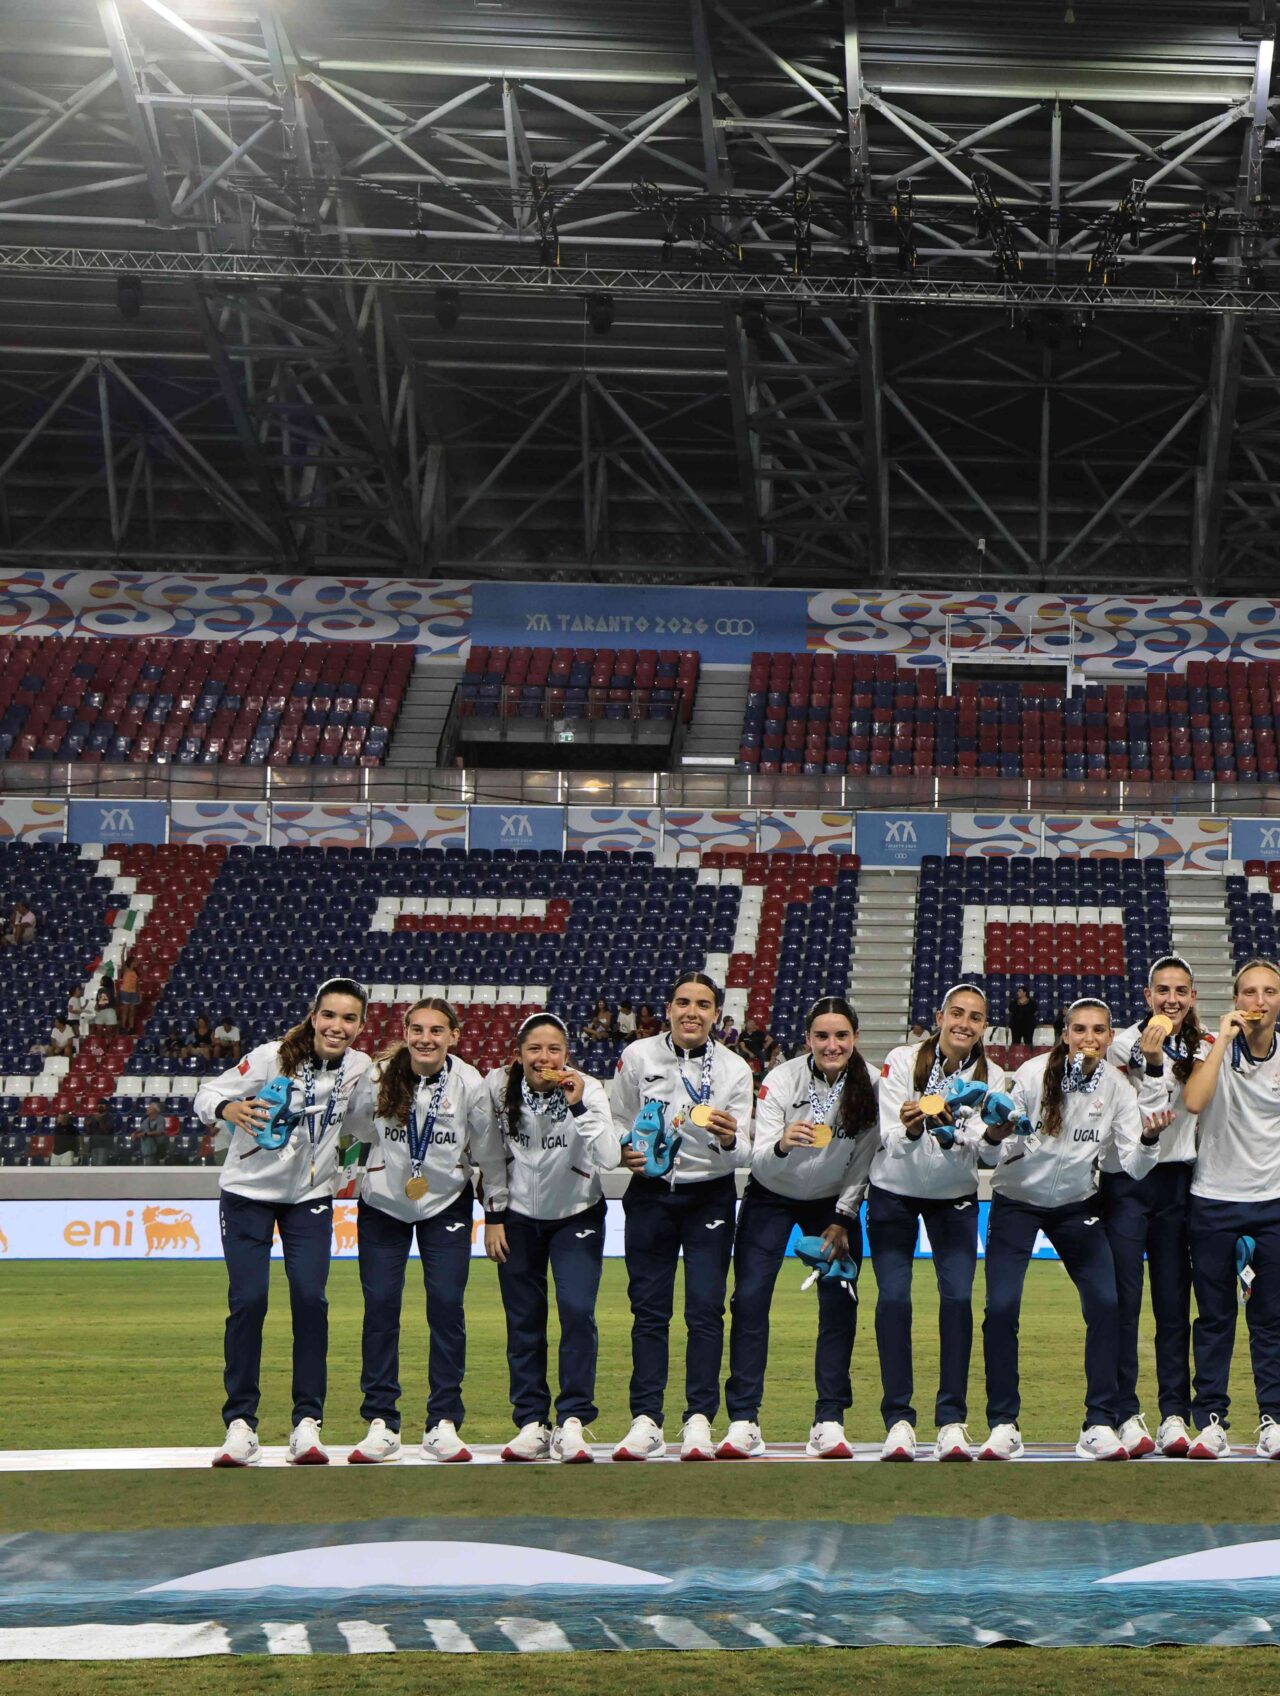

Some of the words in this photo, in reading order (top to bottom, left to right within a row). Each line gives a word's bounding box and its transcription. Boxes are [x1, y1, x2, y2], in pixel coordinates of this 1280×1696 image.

[557, 615, 650, 633] TARANTO
[655, 617, 709, 634] 2026
[63, 1209, 135, 1248] eni
